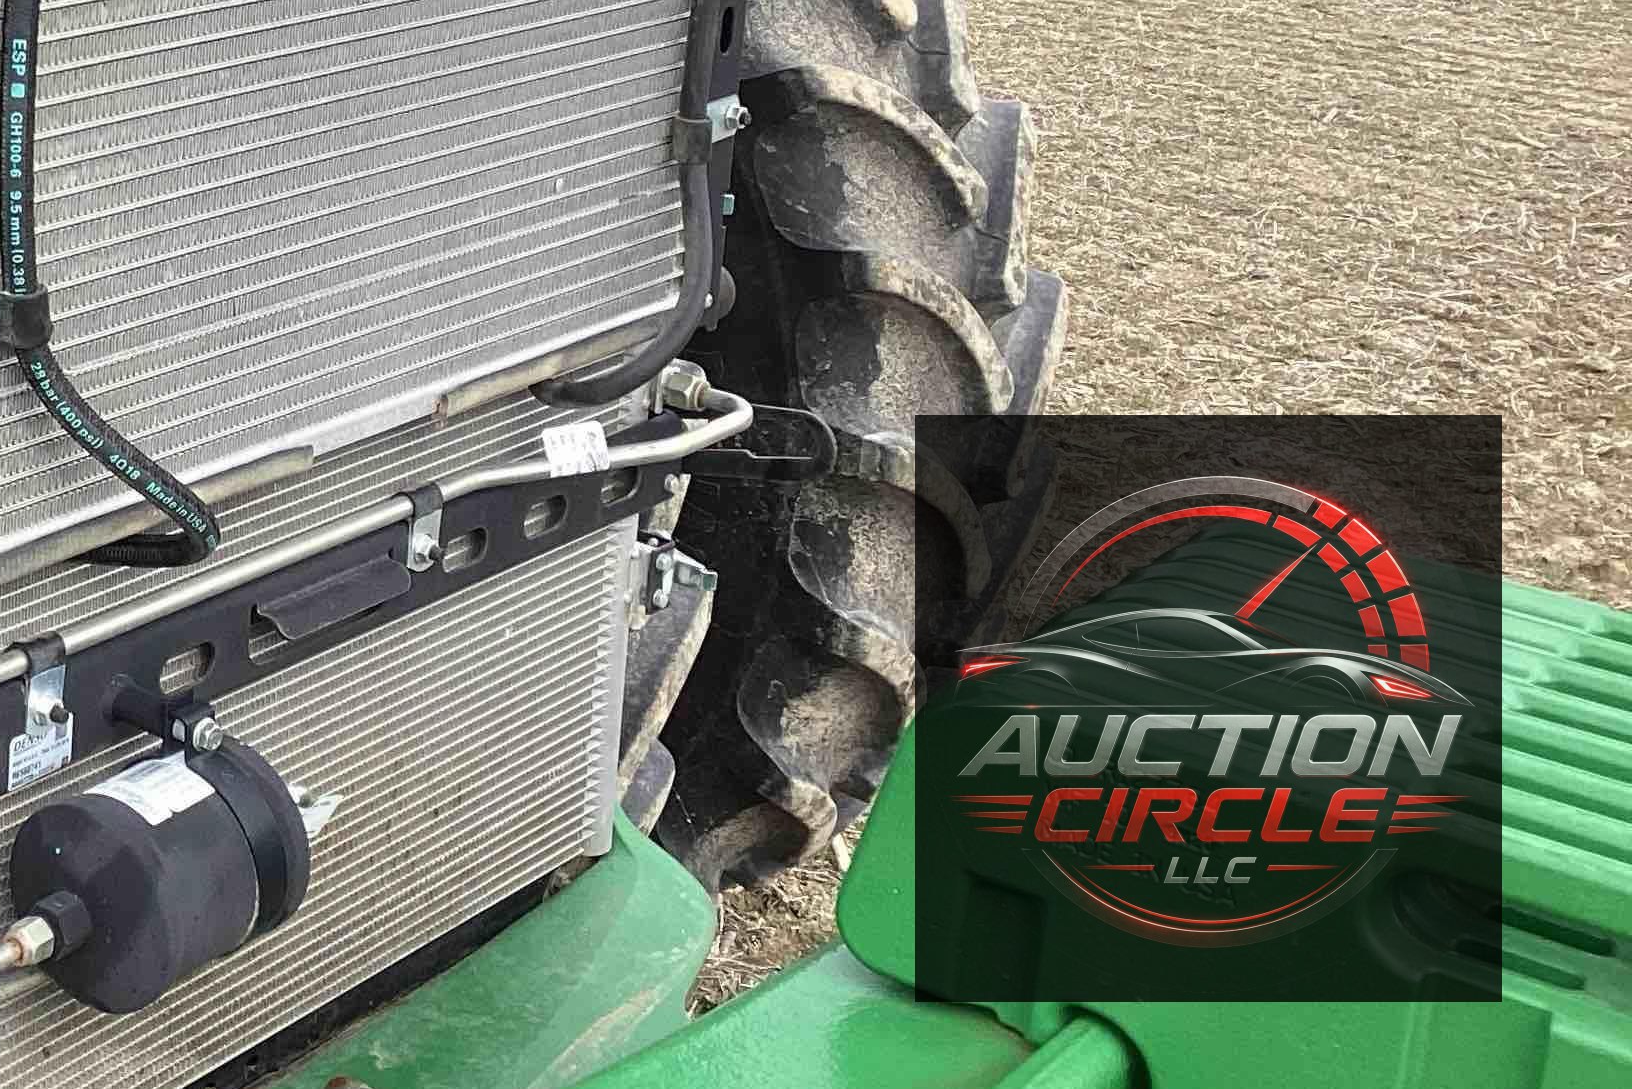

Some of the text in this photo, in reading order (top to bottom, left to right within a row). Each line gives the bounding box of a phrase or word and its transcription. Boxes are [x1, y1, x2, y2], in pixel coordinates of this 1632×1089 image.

[11, 38, 28, 77] ESP
[9, 111, 24, 179] GH100-6
[9, 190, 23, 214] 9.5
[10, 217, 20, 246] mm
[145, 481, 178, 510] Made
[185, 513, 208, 534] USA
